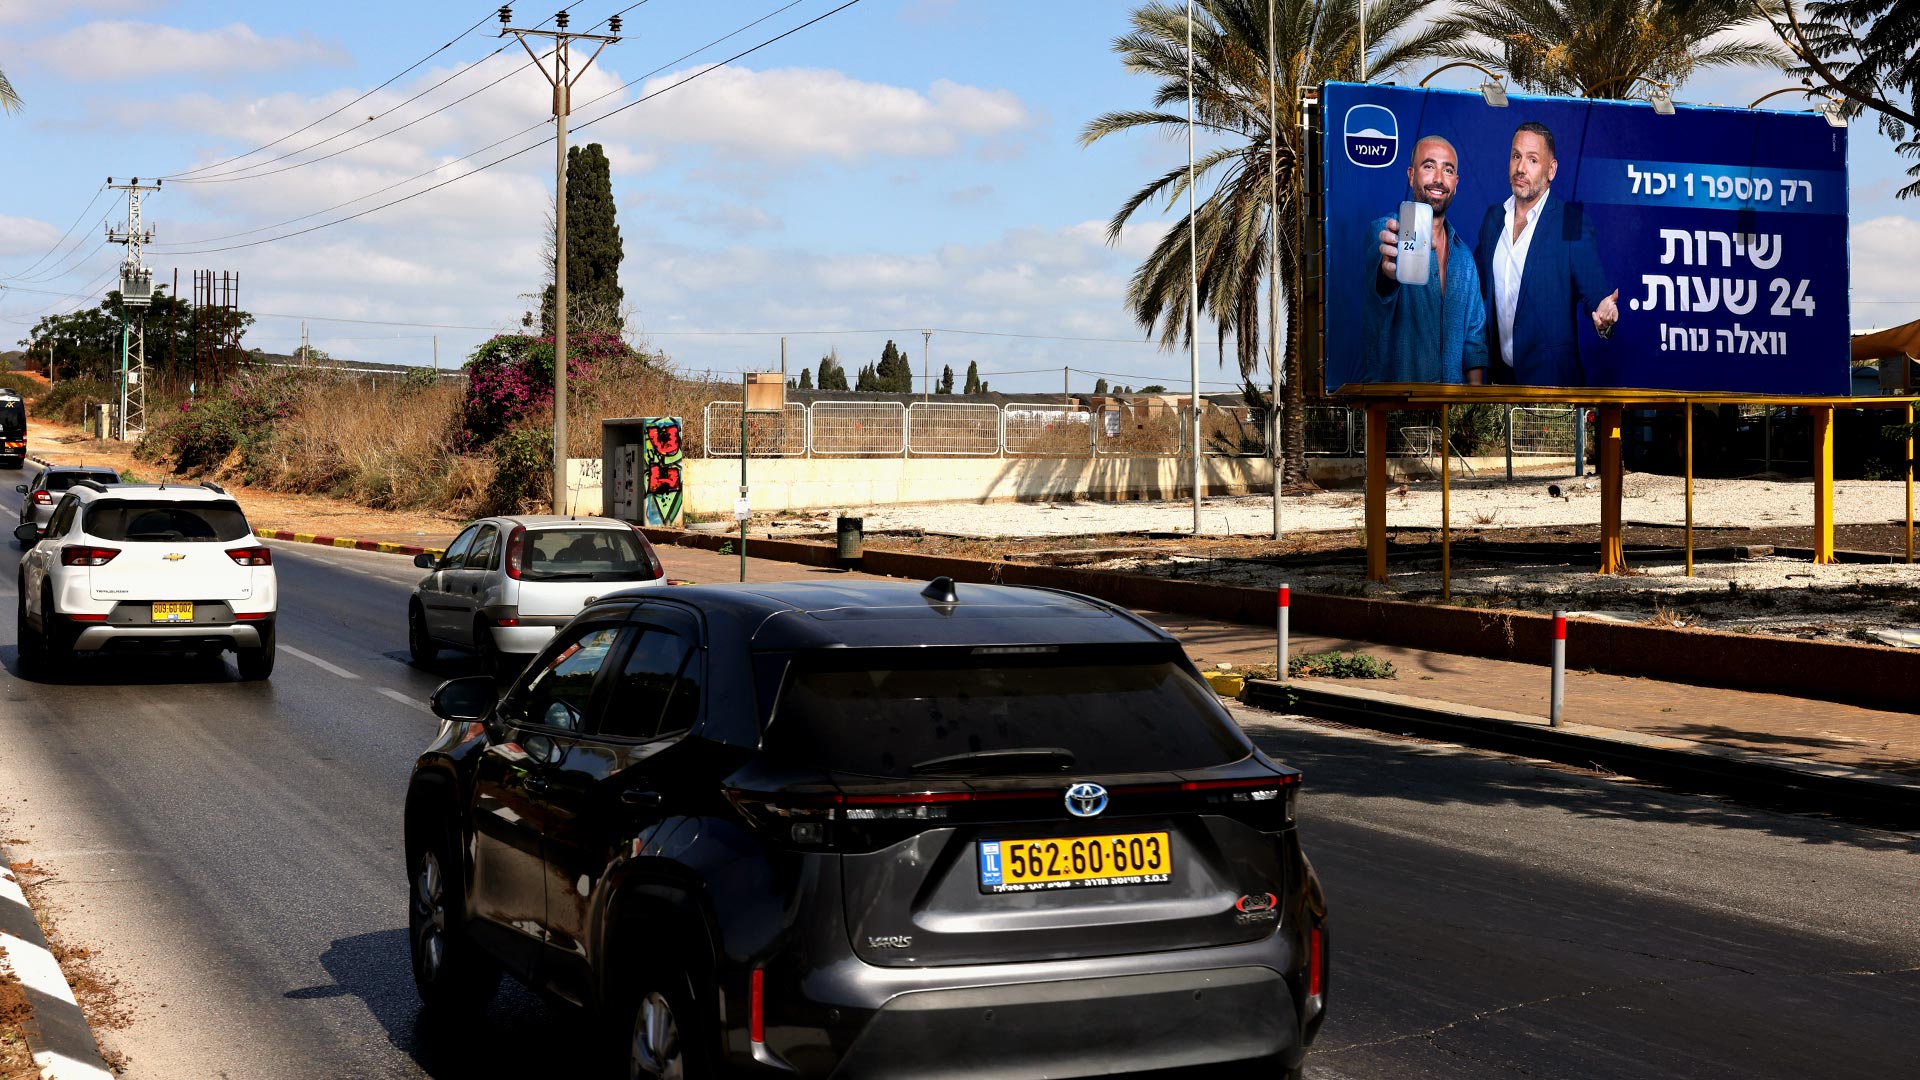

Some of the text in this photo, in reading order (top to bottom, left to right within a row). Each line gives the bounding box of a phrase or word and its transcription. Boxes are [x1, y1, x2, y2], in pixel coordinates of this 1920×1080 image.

[1355, 144, 1388, 157] לאומי
[1627, 164, 1813, 206] רק מספר 1 יכול
[1403, 240, 1415, 251] 24
[1659, 228, 1782, 270] שירות
[1629, 274, 1816, 317] 24 שעות.
[1660, 323, 1787, 355] וואלה נוח!
[986, 854, 999, 872] IL
